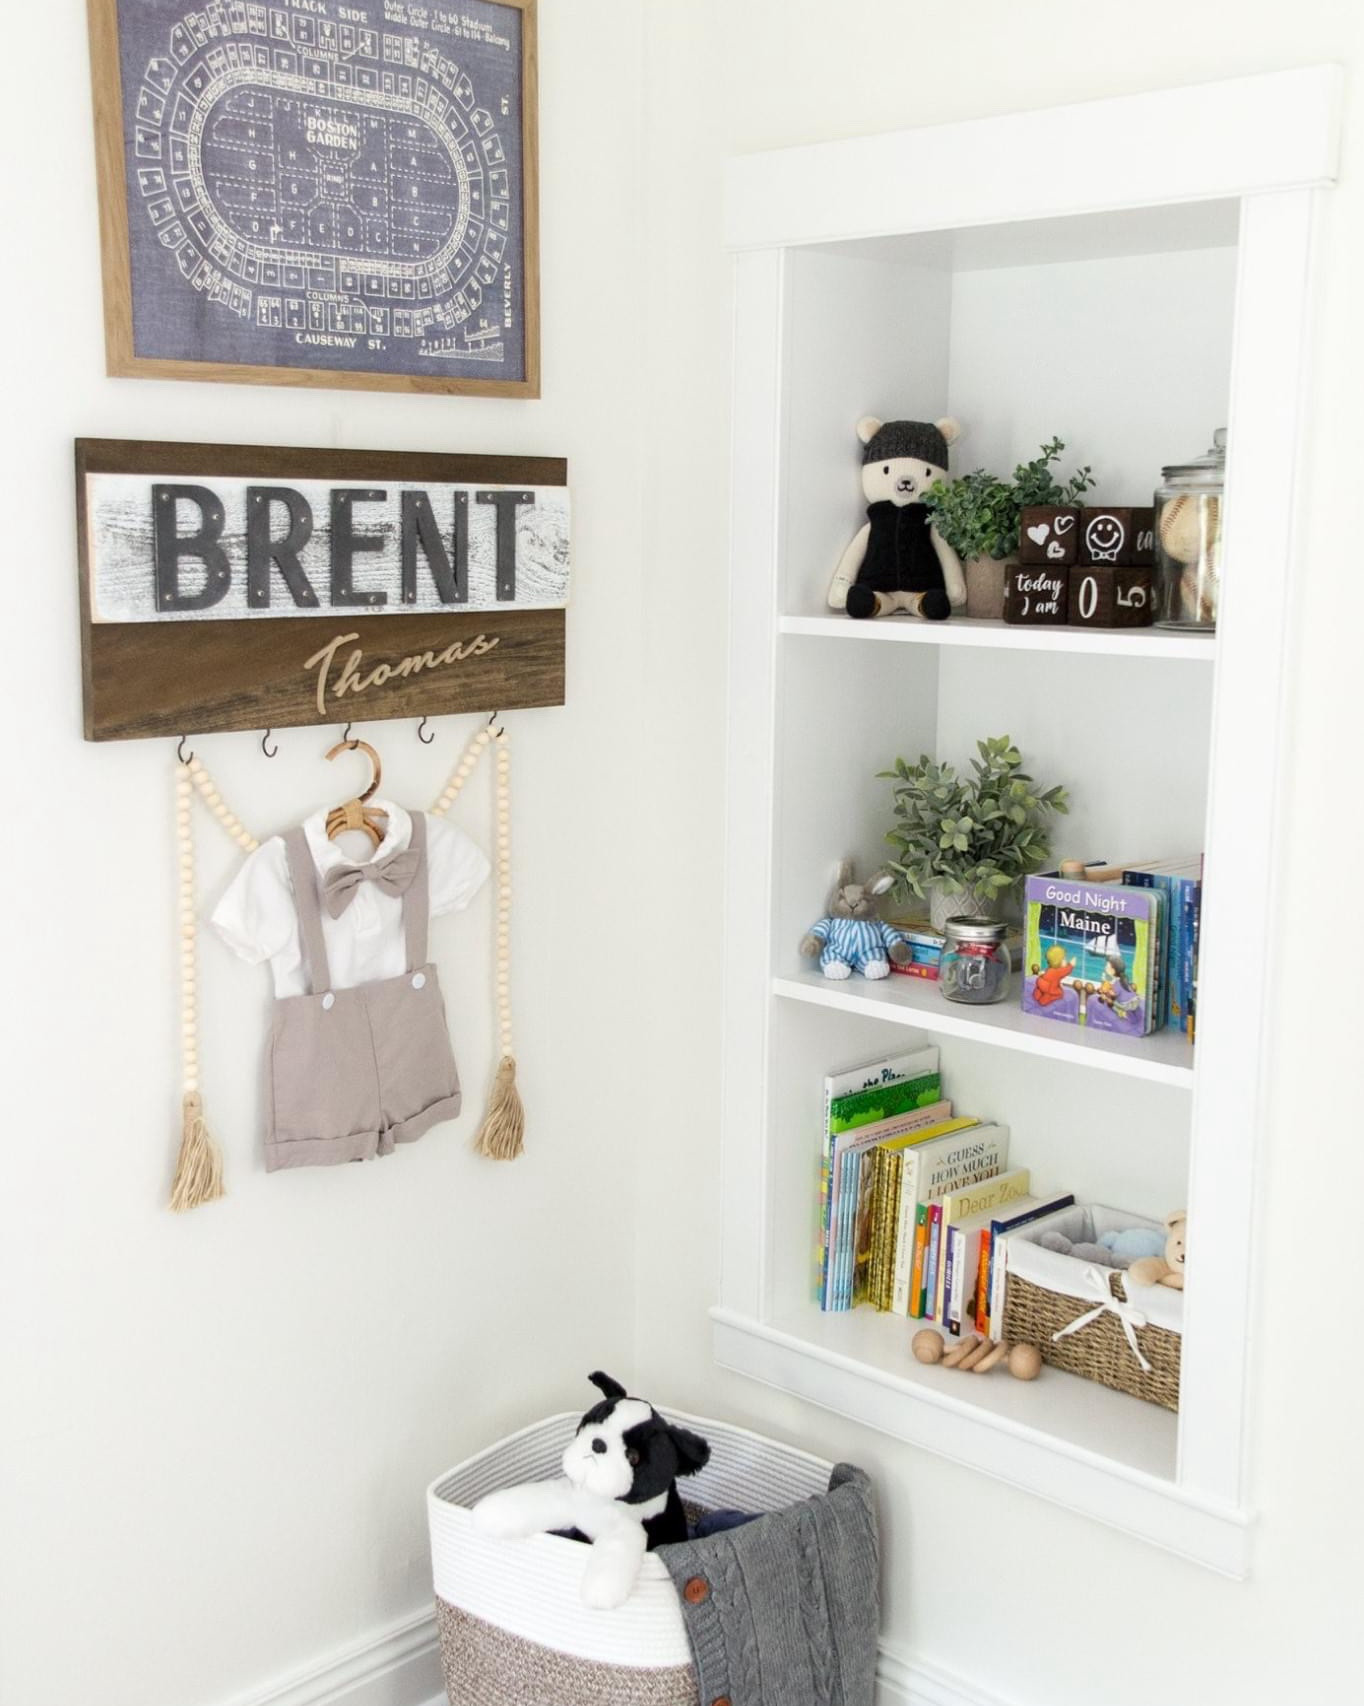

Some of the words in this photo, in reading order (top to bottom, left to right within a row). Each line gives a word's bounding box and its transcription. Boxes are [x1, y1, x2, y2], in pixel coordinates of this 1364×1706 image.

[338, 6, 368, 23] SIDE
[407, 3, 428, 19] Circle
[448, 13, 459, 25] 60
[461, 15, 493, 33] Stadium
[384, 11, 408, 25] Middle
[409, 15, 429, 30] Outer
[431, 20, 451, 34] Circle
[485, 31, 511, 52] Balcony
[296, 45, 340, 63] COLUMNS
[307, 116, 358, 137] BOSTON
[306, 130, 358, 150] GARDEN
[306, 291, 350, 304] COLUMNS
[503, 262, 513, 328] BEVERLY
[295, 333, 358, 349] CAUSEWAY
[367, 339, 387, 351] ST.
[151, 483, 536, 613] BRENT
[1015, 572, 1064, 602] today
[1116, 584, 1147, 608] 5
[1035, 601, 1060, 616] am
[303, 631, 500, 716] Thomas
[1045, 885, 1082, 905] Good
[1084, 891, 1128, 914] Night
[1059, 910, 1112, 935] Maine
[947, 1142, 985, 1165] GUESS
[931, 1168, 960, 1185] HOW
[961, 1152, 999, 1174] MUCH
[927, 1189, 933, 1201] I
[936, 1176, 970, 1197] LOVE
[972, 1166, 1000, 1184] YOU
[958, 1193, 996, 1218] Dear
